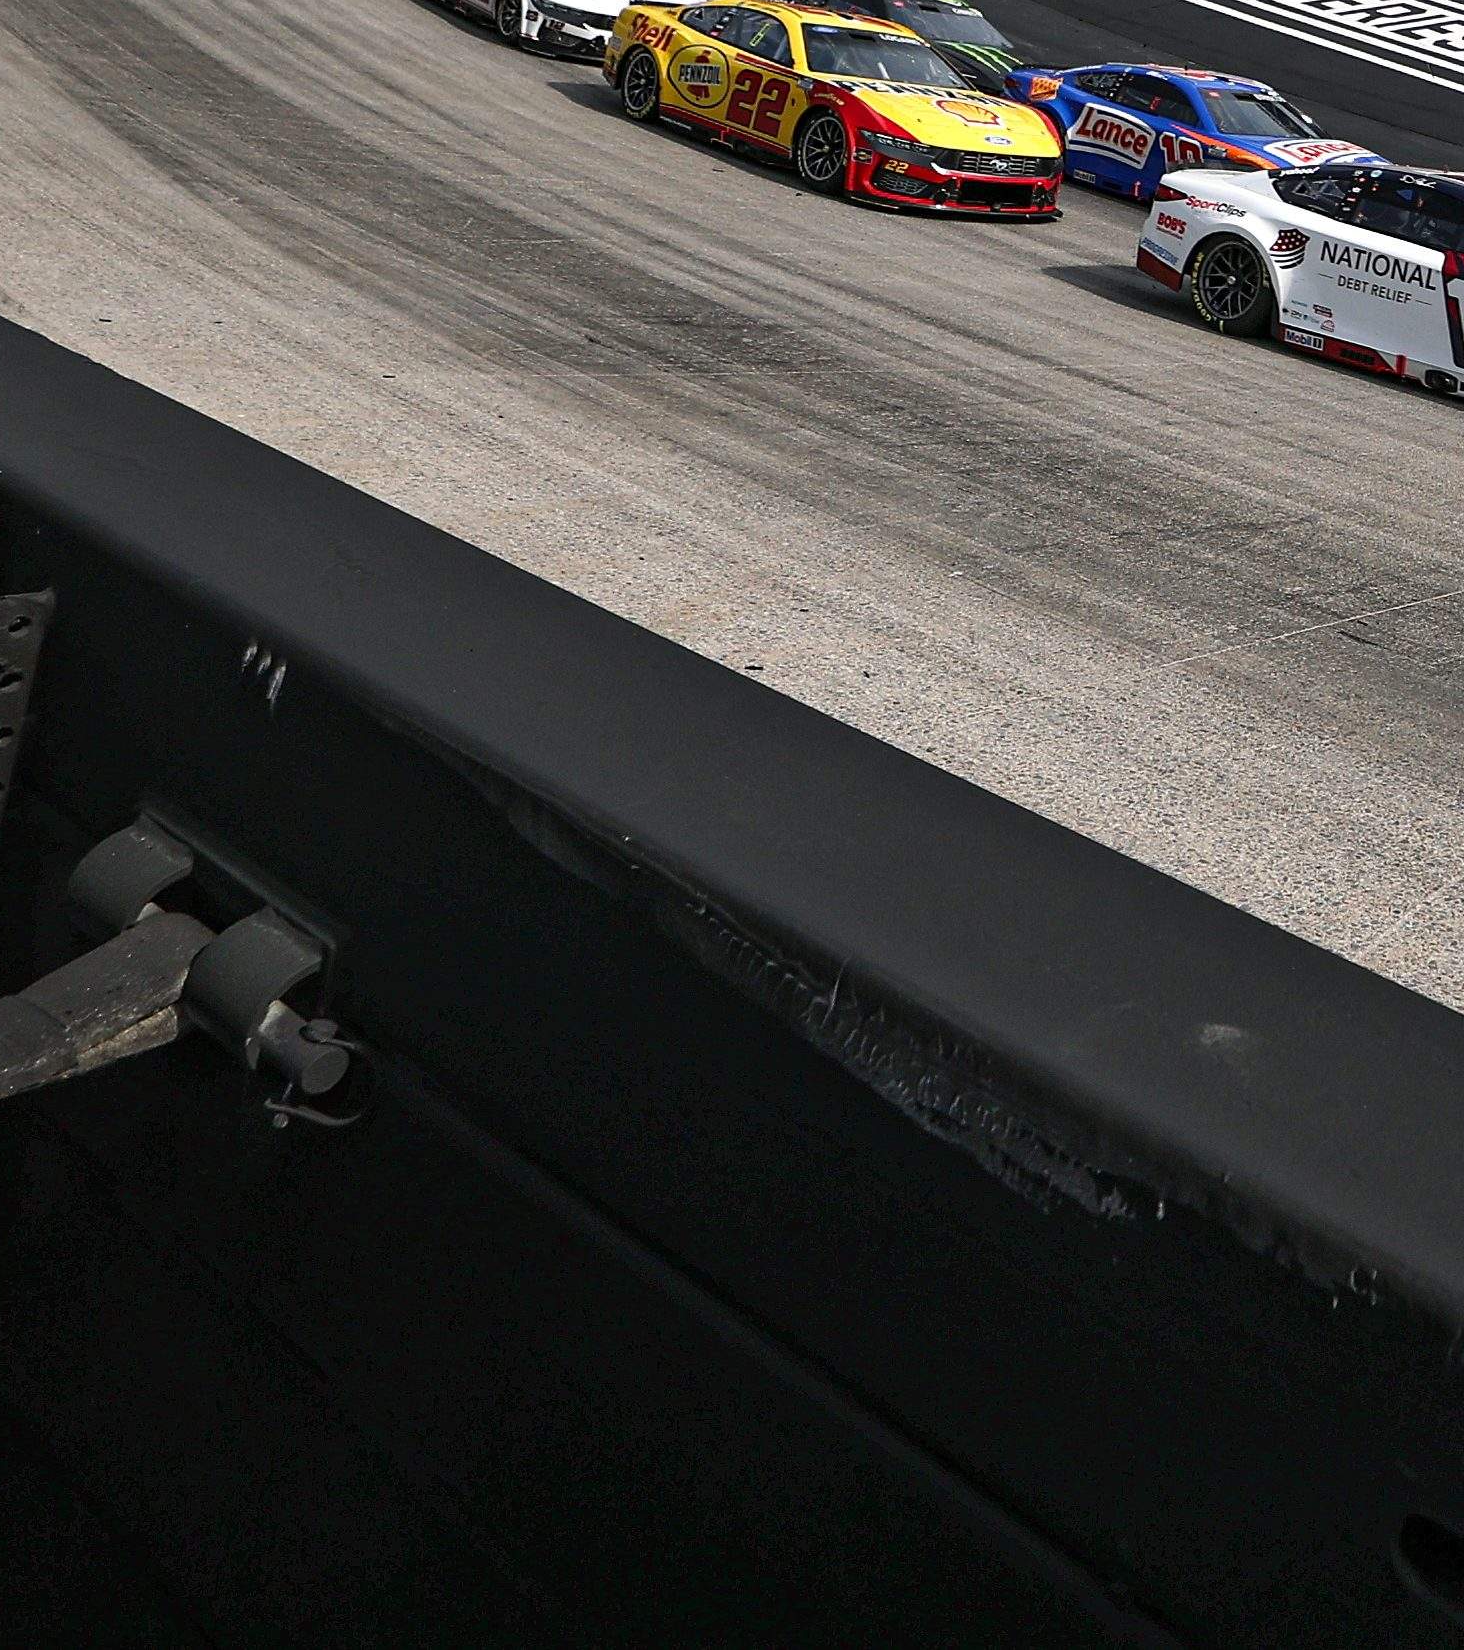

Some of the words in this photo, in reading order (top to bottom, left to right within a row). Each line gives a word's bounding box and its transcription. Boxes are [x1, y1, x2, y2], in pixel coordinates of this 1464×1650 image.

[630, 12, 678, 52] Shell
[677, 63, 722, 86] PENNZOIL
[725, 68, 792, 138] 22
[1074, 106, 1150, 157] Lance
[884, 158, 910, 174] 22
[1282, 139, 1359, 166] Lance
[1156, 211, 1188, 236] BOB'S
[1319, 240, 1437, 293] NATIONAL
[1337, 274, 1369, 294] DEBT
[1370, 279, 1413, 305] RELIEF
[1285, 329, 1313, 348] Mobil
